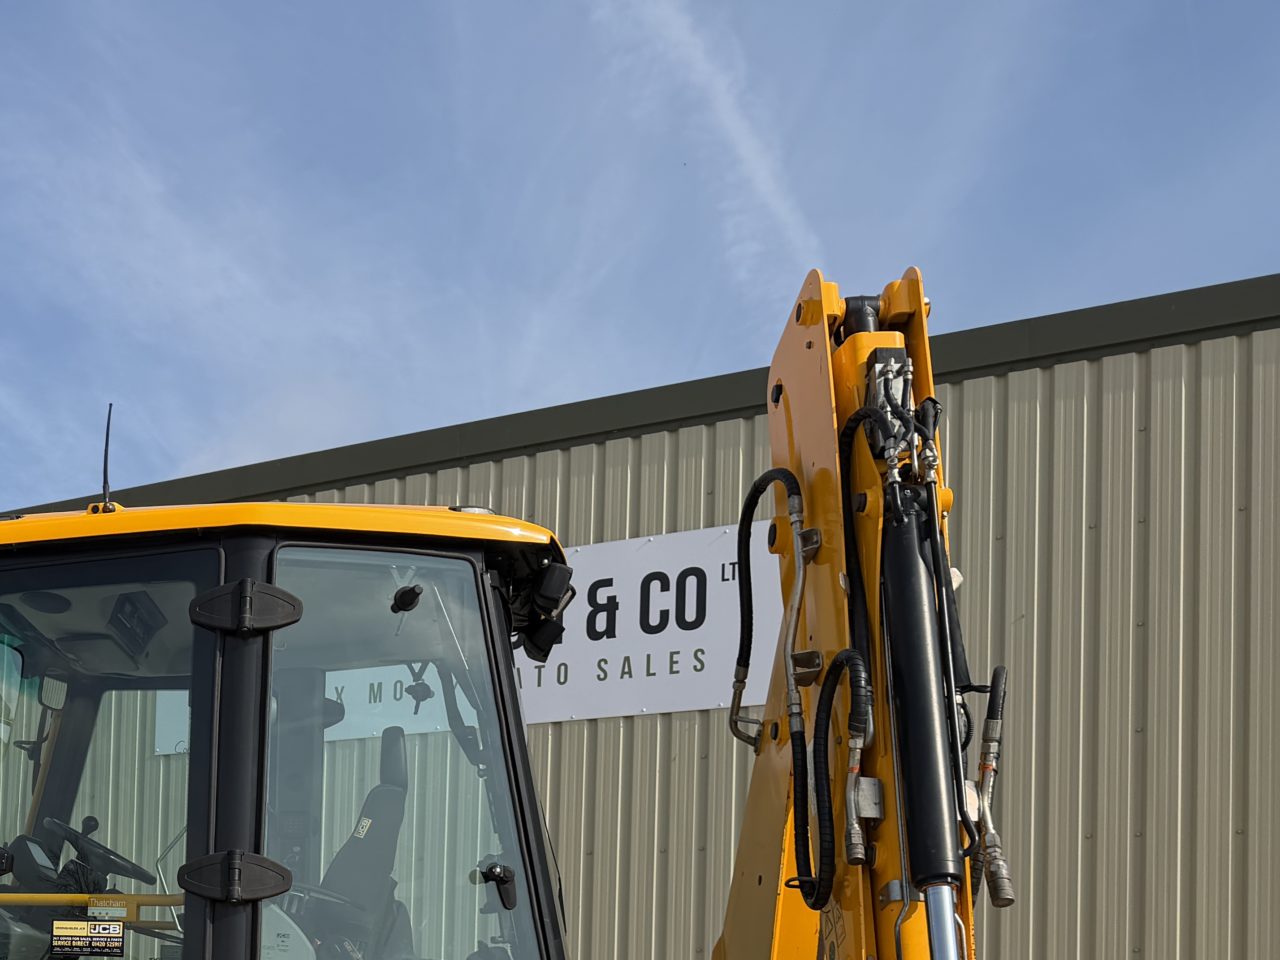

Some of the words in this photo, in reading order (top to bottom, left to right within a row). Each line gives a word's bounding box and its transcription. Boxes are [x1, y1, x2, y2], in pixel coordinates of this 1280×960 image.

[586, 577, 620, 641] &
[639, 566, 707, 635] CO
[721, 562, 738, 582] LT
[368, 679, 405, 704] MO
[596, 648, 705, 682] SALES
[90, 924, 120, 934] JCB
